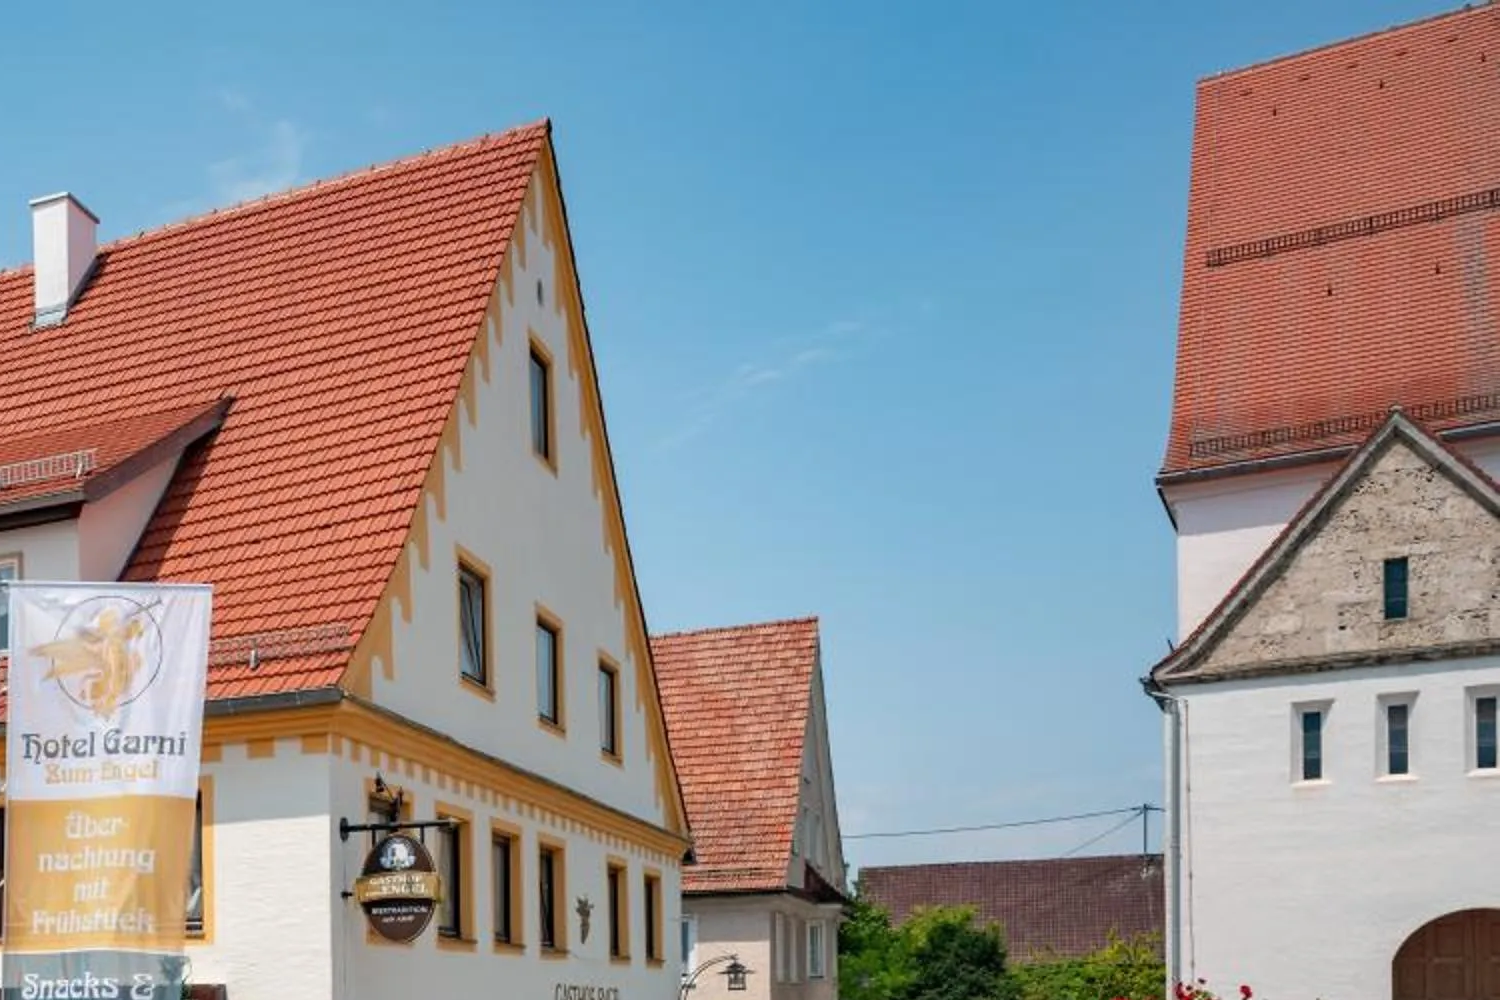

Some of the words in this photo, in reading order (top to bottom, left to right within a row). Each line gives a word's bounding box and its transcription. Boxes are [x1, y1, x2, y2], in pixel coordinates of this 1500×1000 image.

[22, 731, 95, 765] Hotel
[103, 728, 186, 756] Garni
[21, 971, 120, 1000] Snacks
[129, 974, 155, 1000] &
